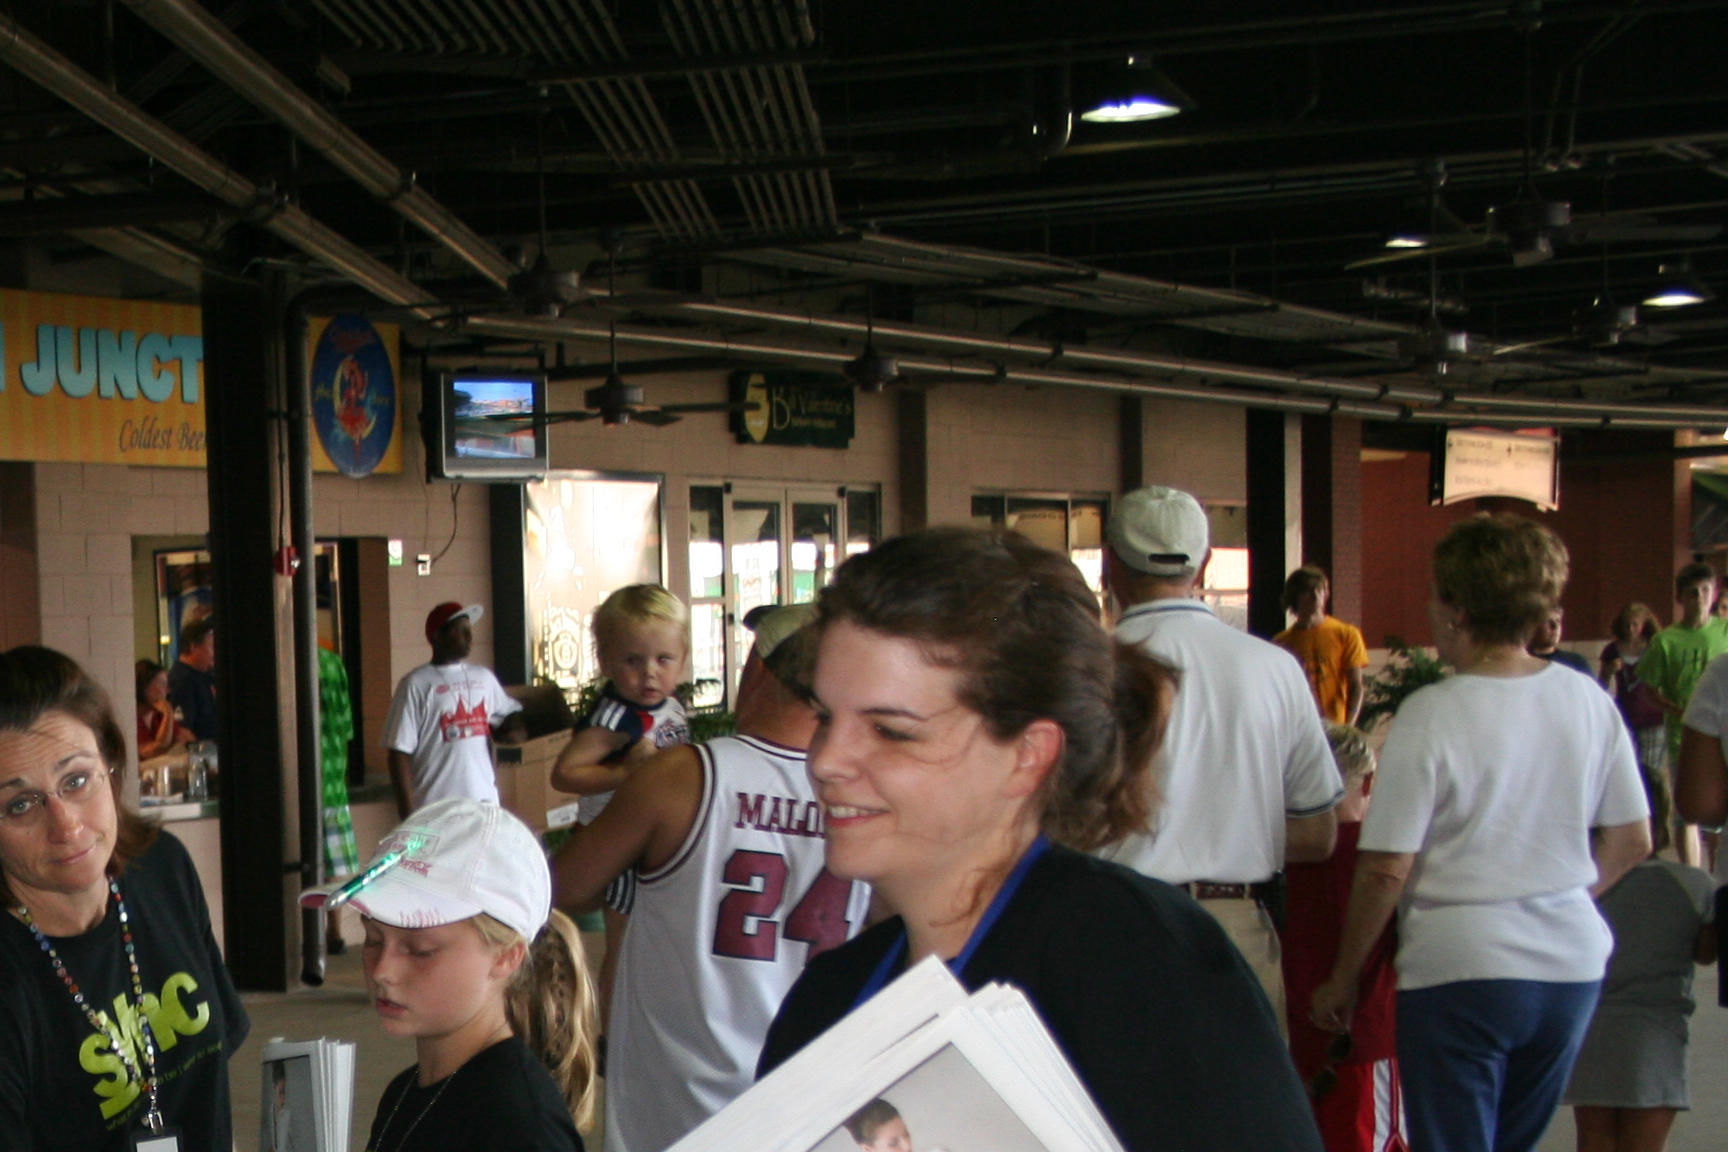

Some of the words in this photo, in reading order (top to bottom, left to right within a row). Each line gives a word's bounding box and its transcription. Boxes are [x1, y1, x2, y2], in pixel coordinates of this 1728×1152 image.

[21, 323, 205, 403] JUNCT
[119, 415, 173, 453] Coldest
[735, 792, 826, 839] MALO
[712, 848, 862, 962] 24
